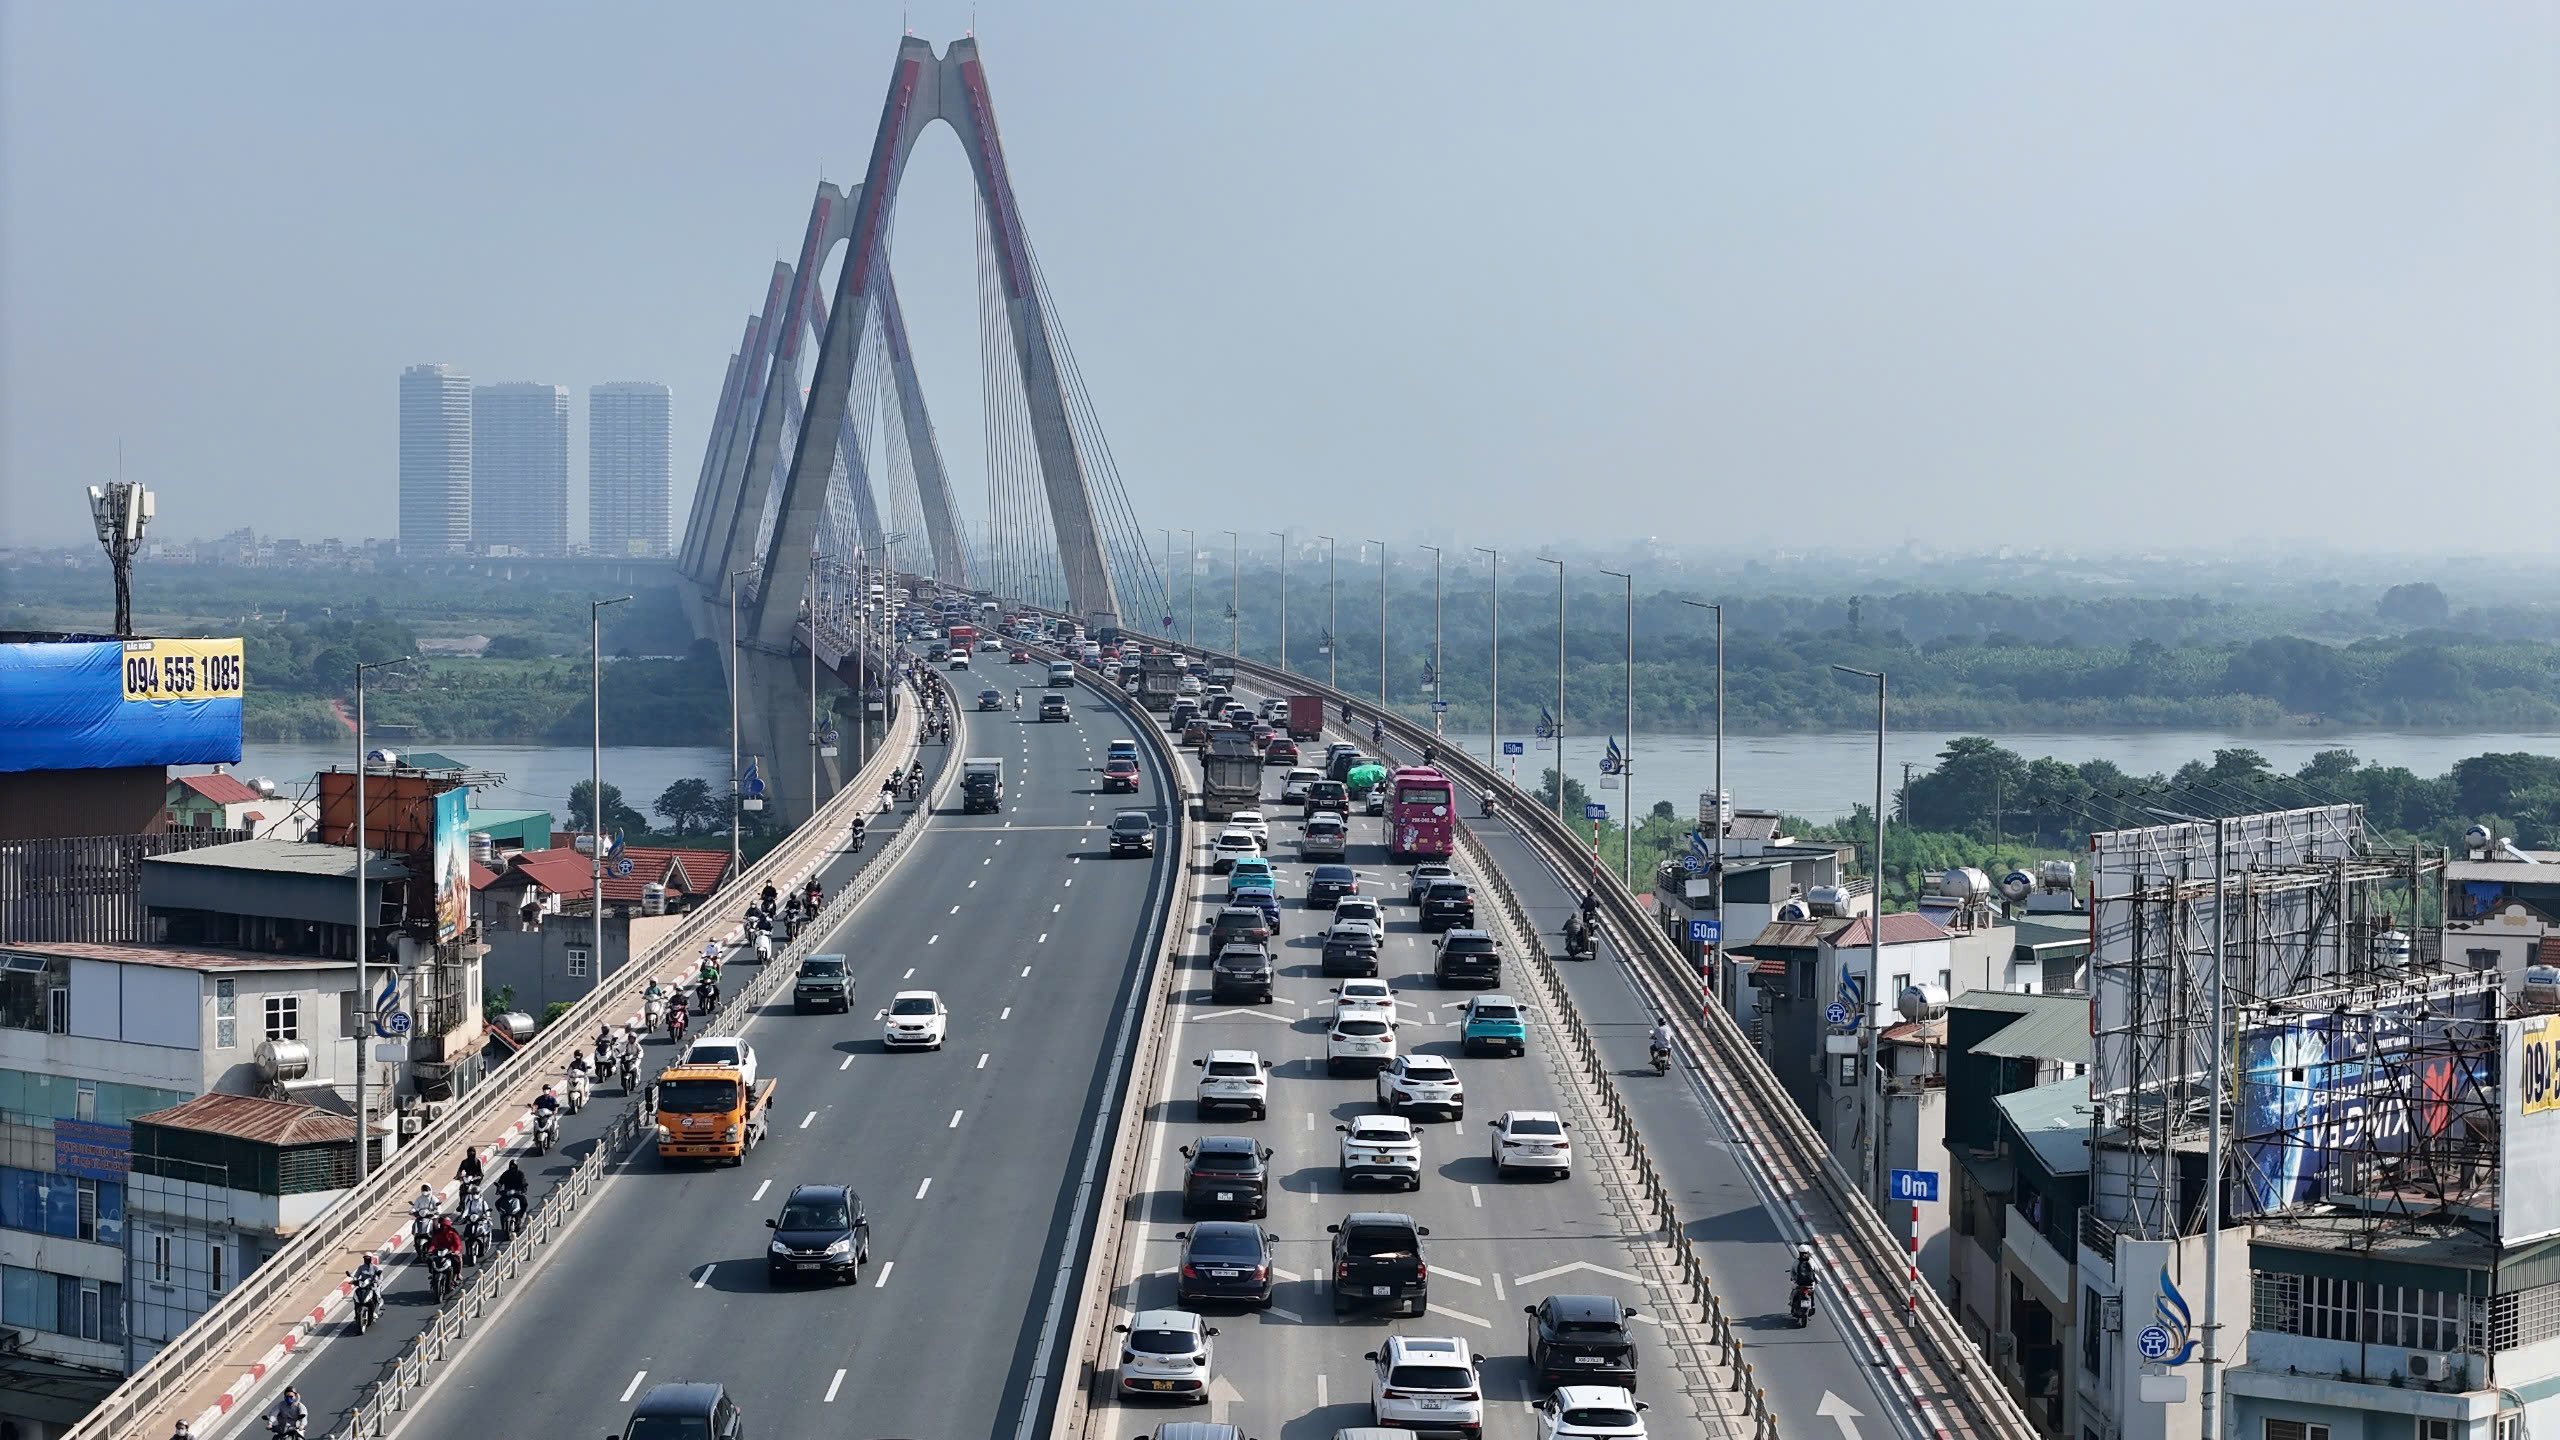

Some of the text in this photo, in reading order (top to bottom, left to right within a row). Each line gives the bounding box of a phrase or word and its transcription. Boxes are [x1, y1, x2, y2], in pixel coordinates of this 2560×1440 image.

[127, 654, 240, 694] 094 555 1085
[1505, 743, 1522, 754] 150m
[1586, 806, 1605, 818] 100m
[1693, 922, 1718, 939] 50m
[2320, 1066, 2347, 1080] BETER
[1901, 1174, 1928, 1198] 0m
